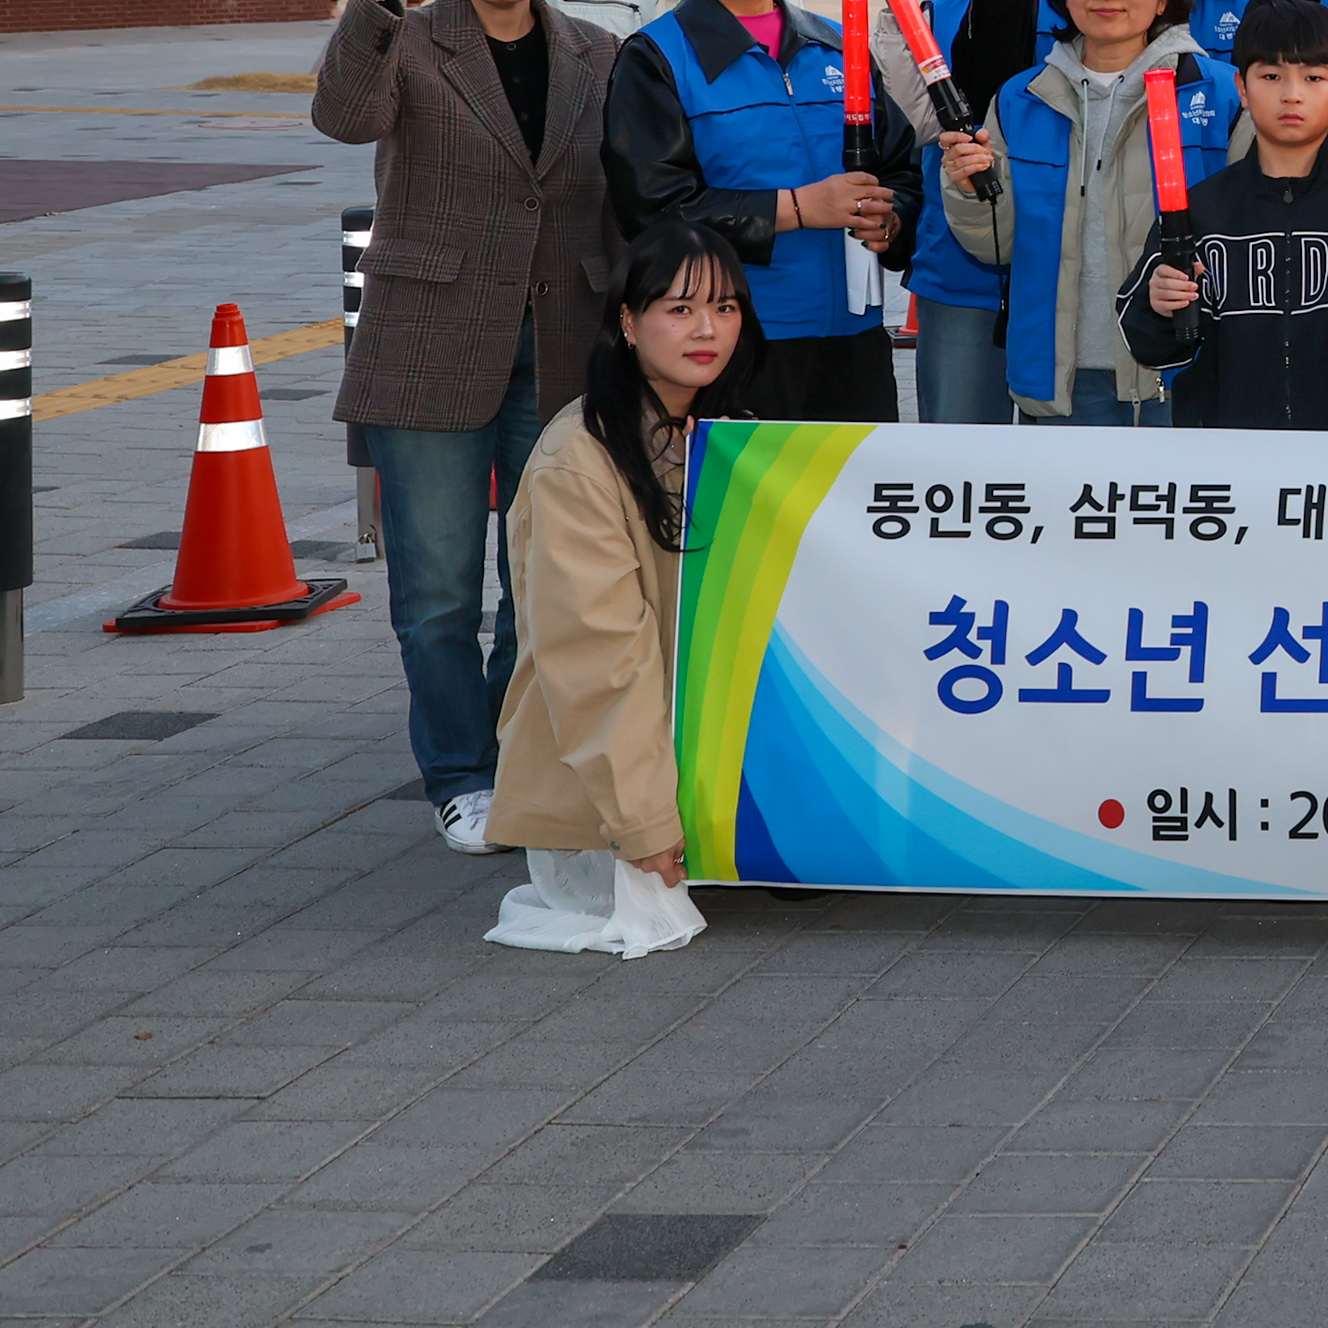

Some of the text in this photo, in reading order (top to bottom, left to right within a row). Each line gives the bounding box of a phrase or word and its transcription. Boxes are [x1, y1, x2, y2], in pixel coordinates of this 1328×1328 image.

[867, 481, 1044, 544] 동인동,
[1069, 482, 1248, 545] 삼덕동,
[923, 594, 1208, 715] 청소년
[1147, 787, 1238, 842] 일시
